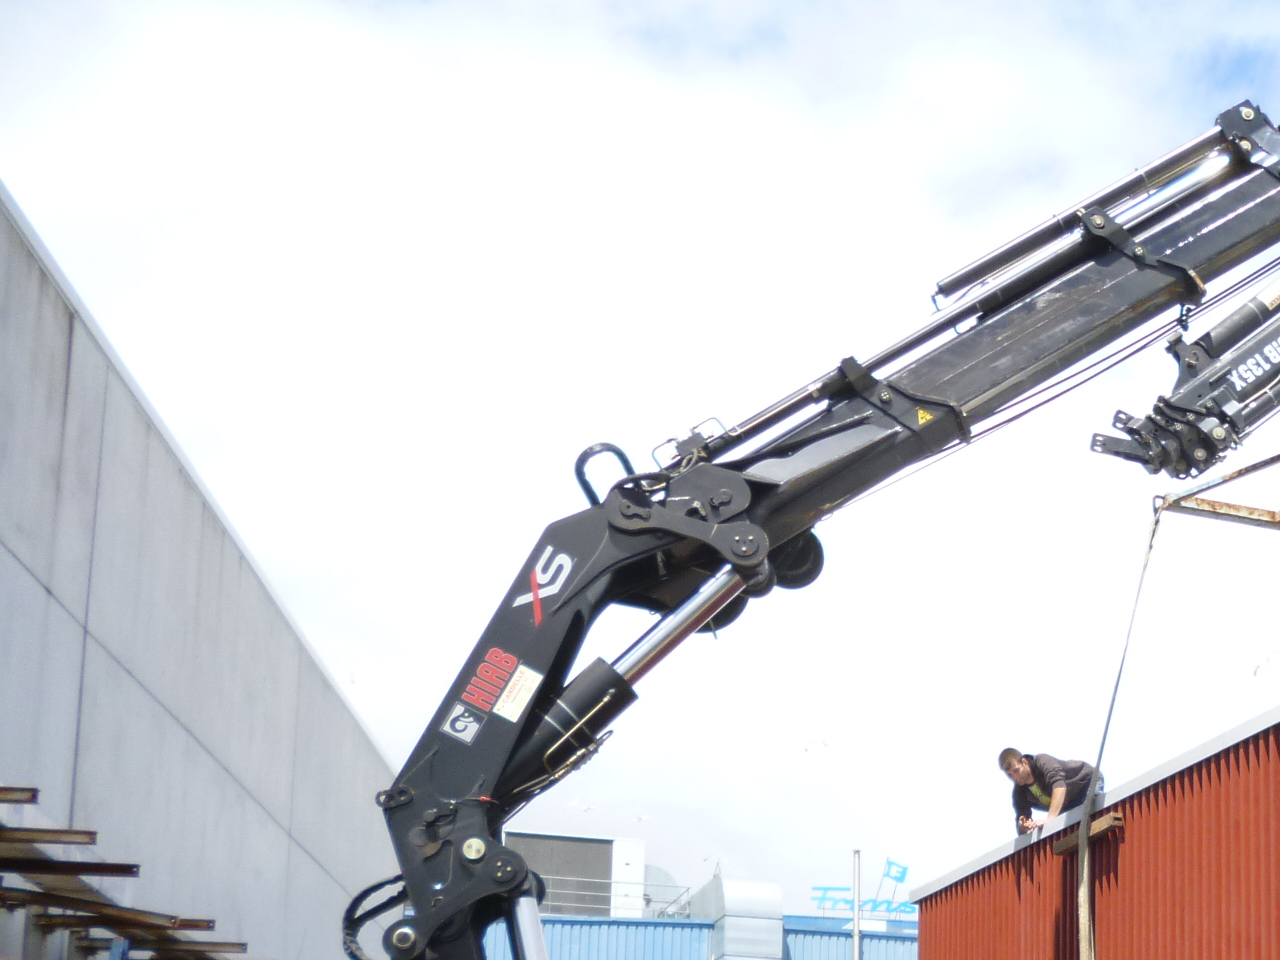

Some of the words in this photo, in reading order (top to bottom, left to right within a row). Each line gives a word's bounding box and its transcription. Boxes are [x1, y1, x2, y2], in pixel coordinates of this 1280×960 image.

[1226, 353, 1271, 391] 135X
[512, 545, 575, 627] XS
[461, 647, 518, 711] HIAB
[502, 669, 526, 704] CARDELLE
